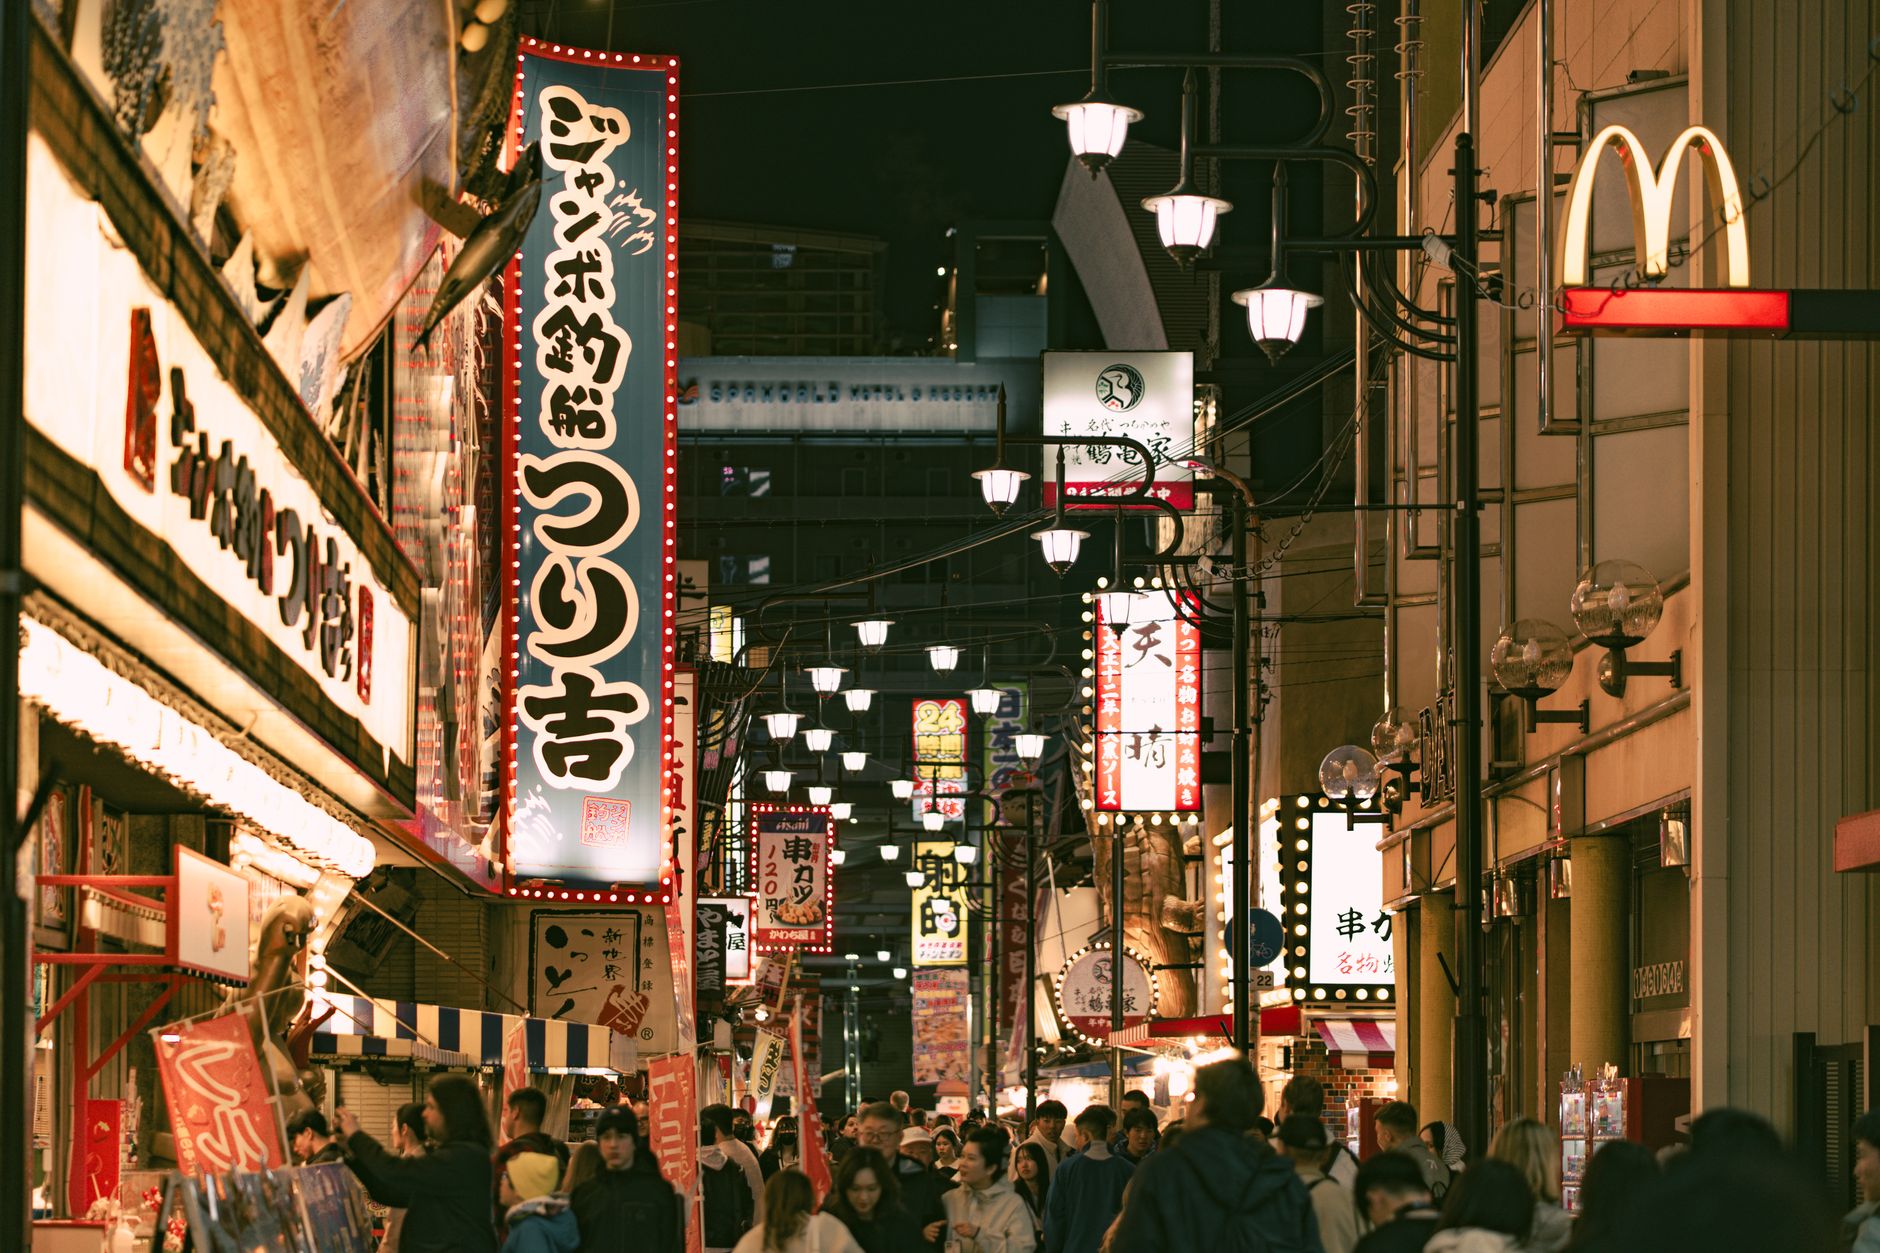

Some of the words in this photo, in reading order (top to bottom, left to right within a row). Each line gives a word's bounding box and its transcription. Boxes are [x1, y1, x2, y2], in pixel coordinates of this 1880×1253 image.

[537, 88, 630, 447] ジャンボ釣船
[518, 452, 648, 789] つり吉
[916, 701, 964, 734] 24
[776, 817, 809, 830] Asahi
[782, 835, 814, 905] 串カツ
